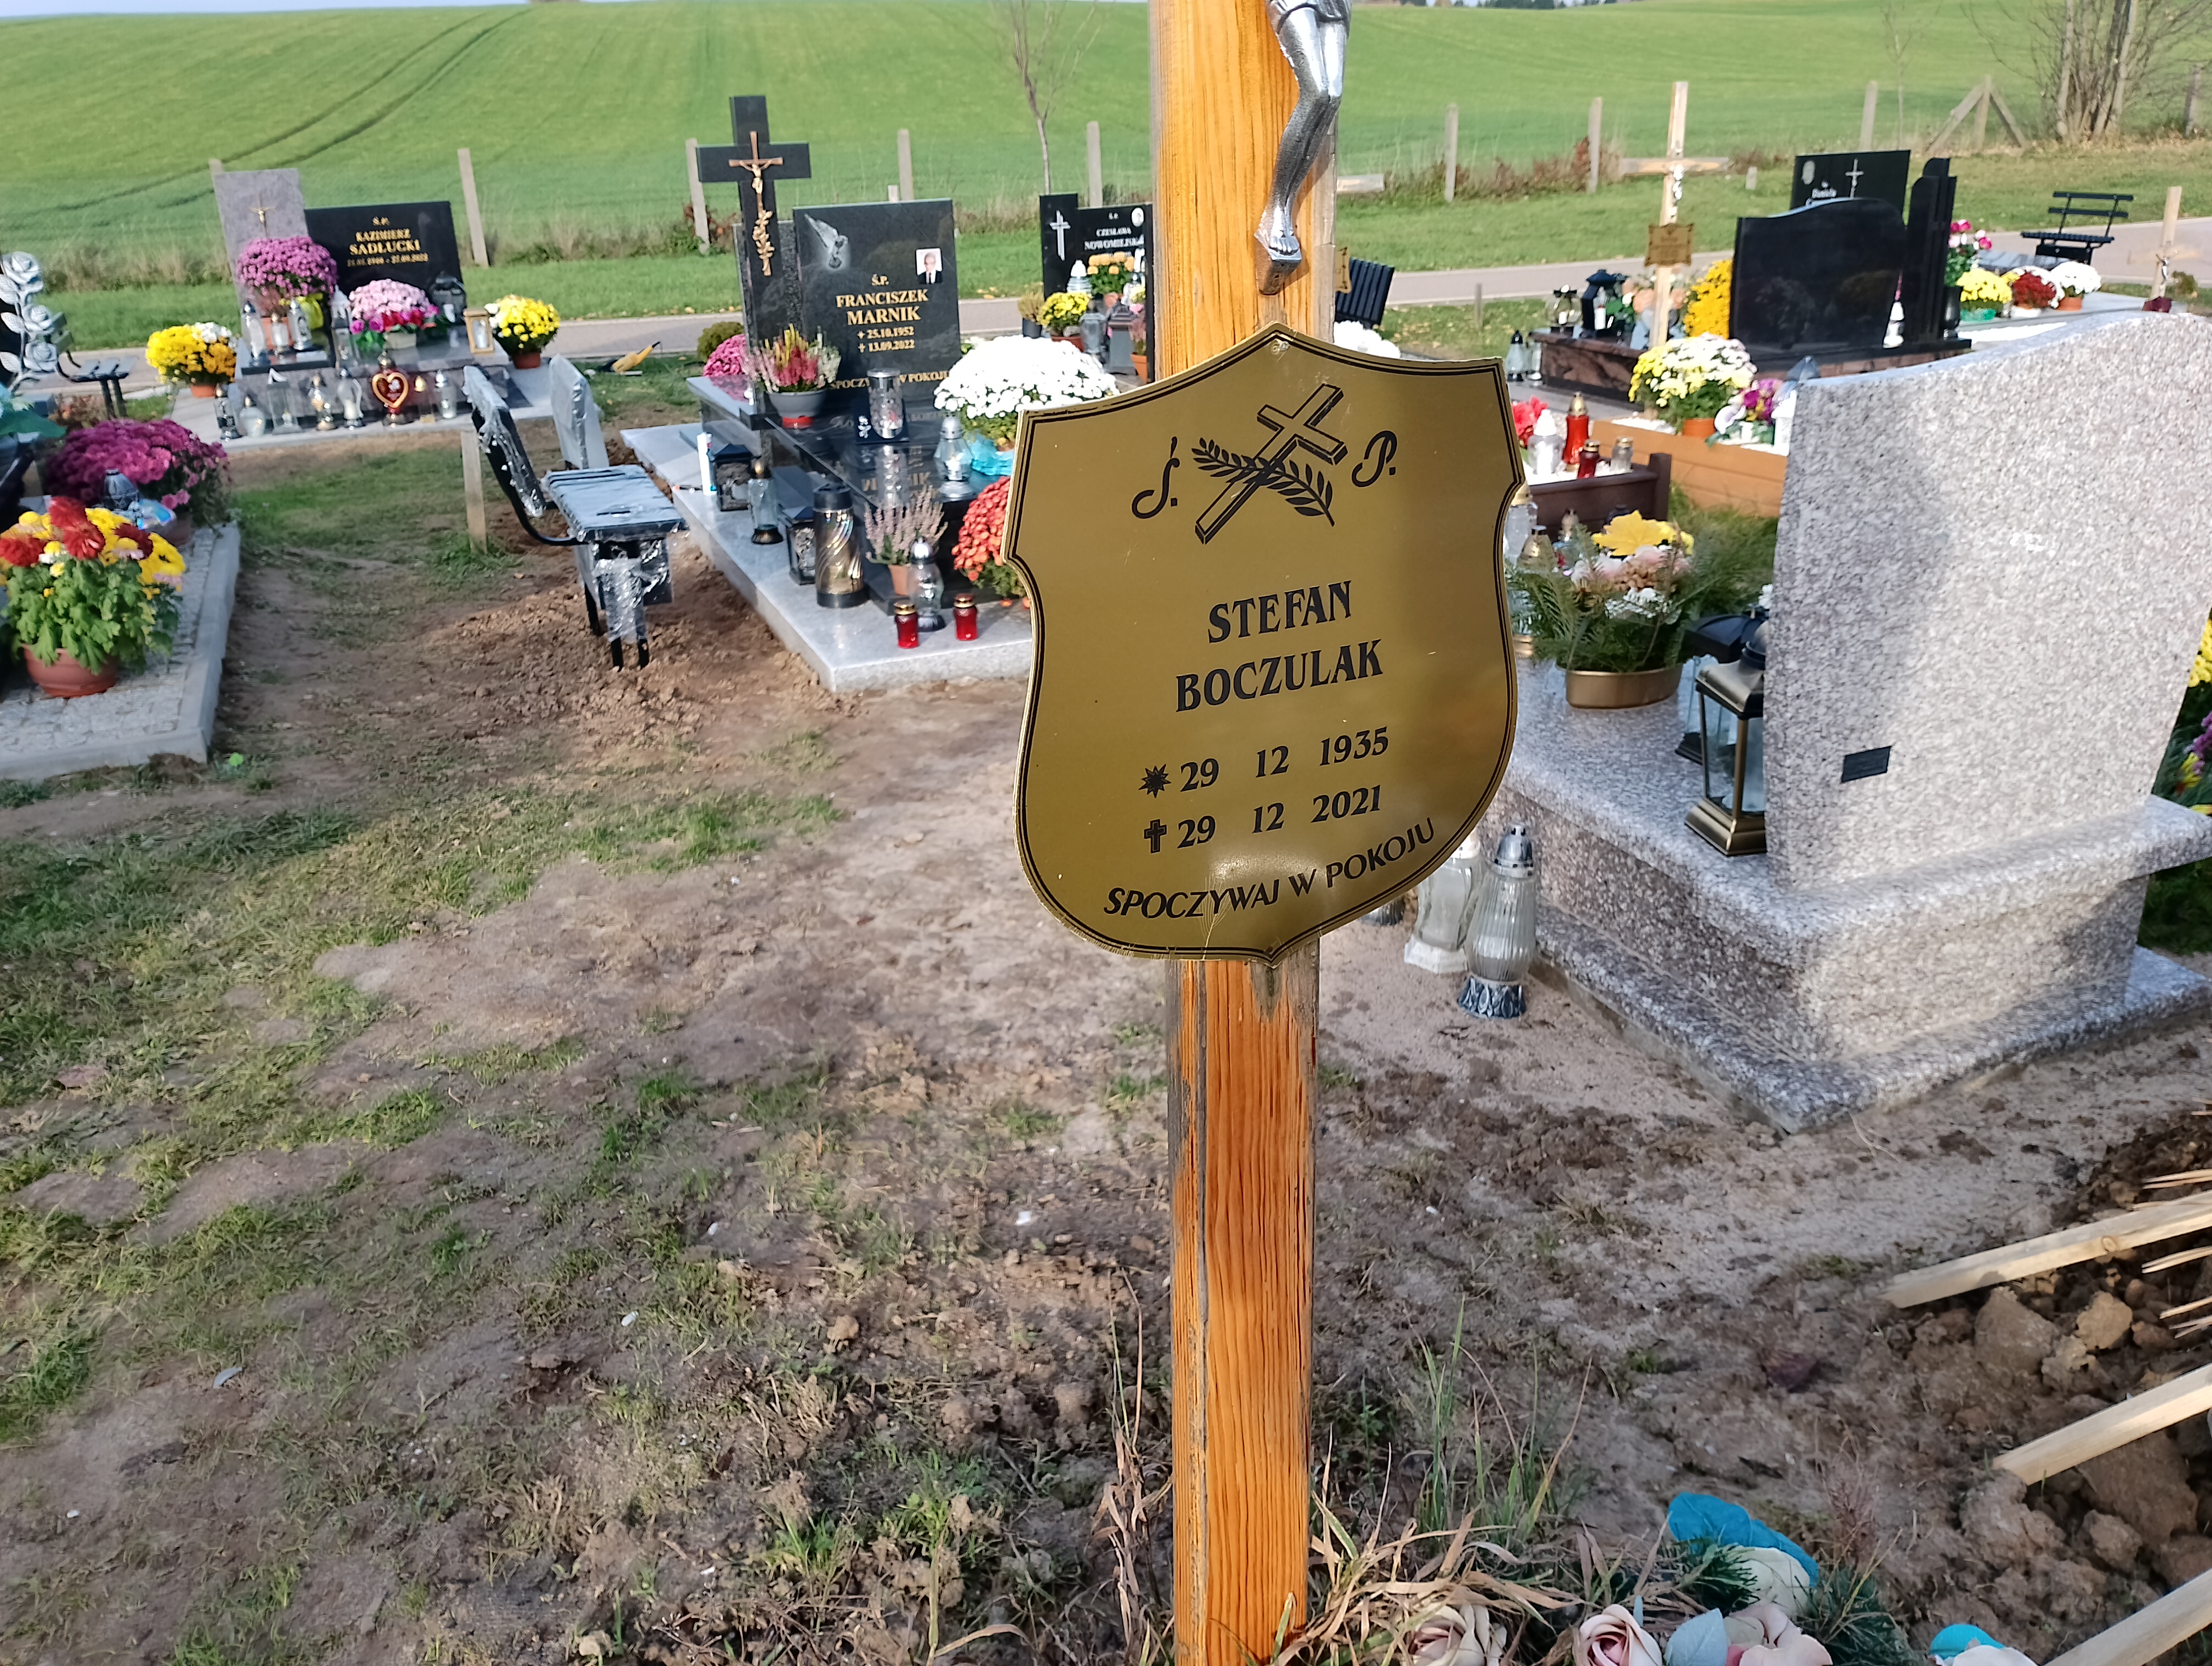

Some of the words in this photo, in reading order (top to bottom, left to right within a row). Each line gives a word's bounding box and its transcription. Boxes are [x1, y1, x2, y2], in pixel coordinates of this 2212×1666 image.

[835, 289, 929, 308] FRANCISZEK
[871, 273, 890, 286] Ś.P.
[846, 306, 922, 325] MARNIK
[1208, 580, 1352, 644] STEFAN
[1175, 638, 1384, 713] BOCZULAK
[1180, 758, 1220, 792] 29
[1255, 745, 1290, 778] 12
[1319, 726, 1390, 766] 1935
[1177, 815, 1217, 849] 29
[1251, 802, 1285, 834] 12
[1310, 784, 1381, 823] 2021
[1103, 878, 1281, 919] SPOCZYWAJ
[1288, 868, 1317, 898] W
[1326, 817, 1435, 888] POKOJU
